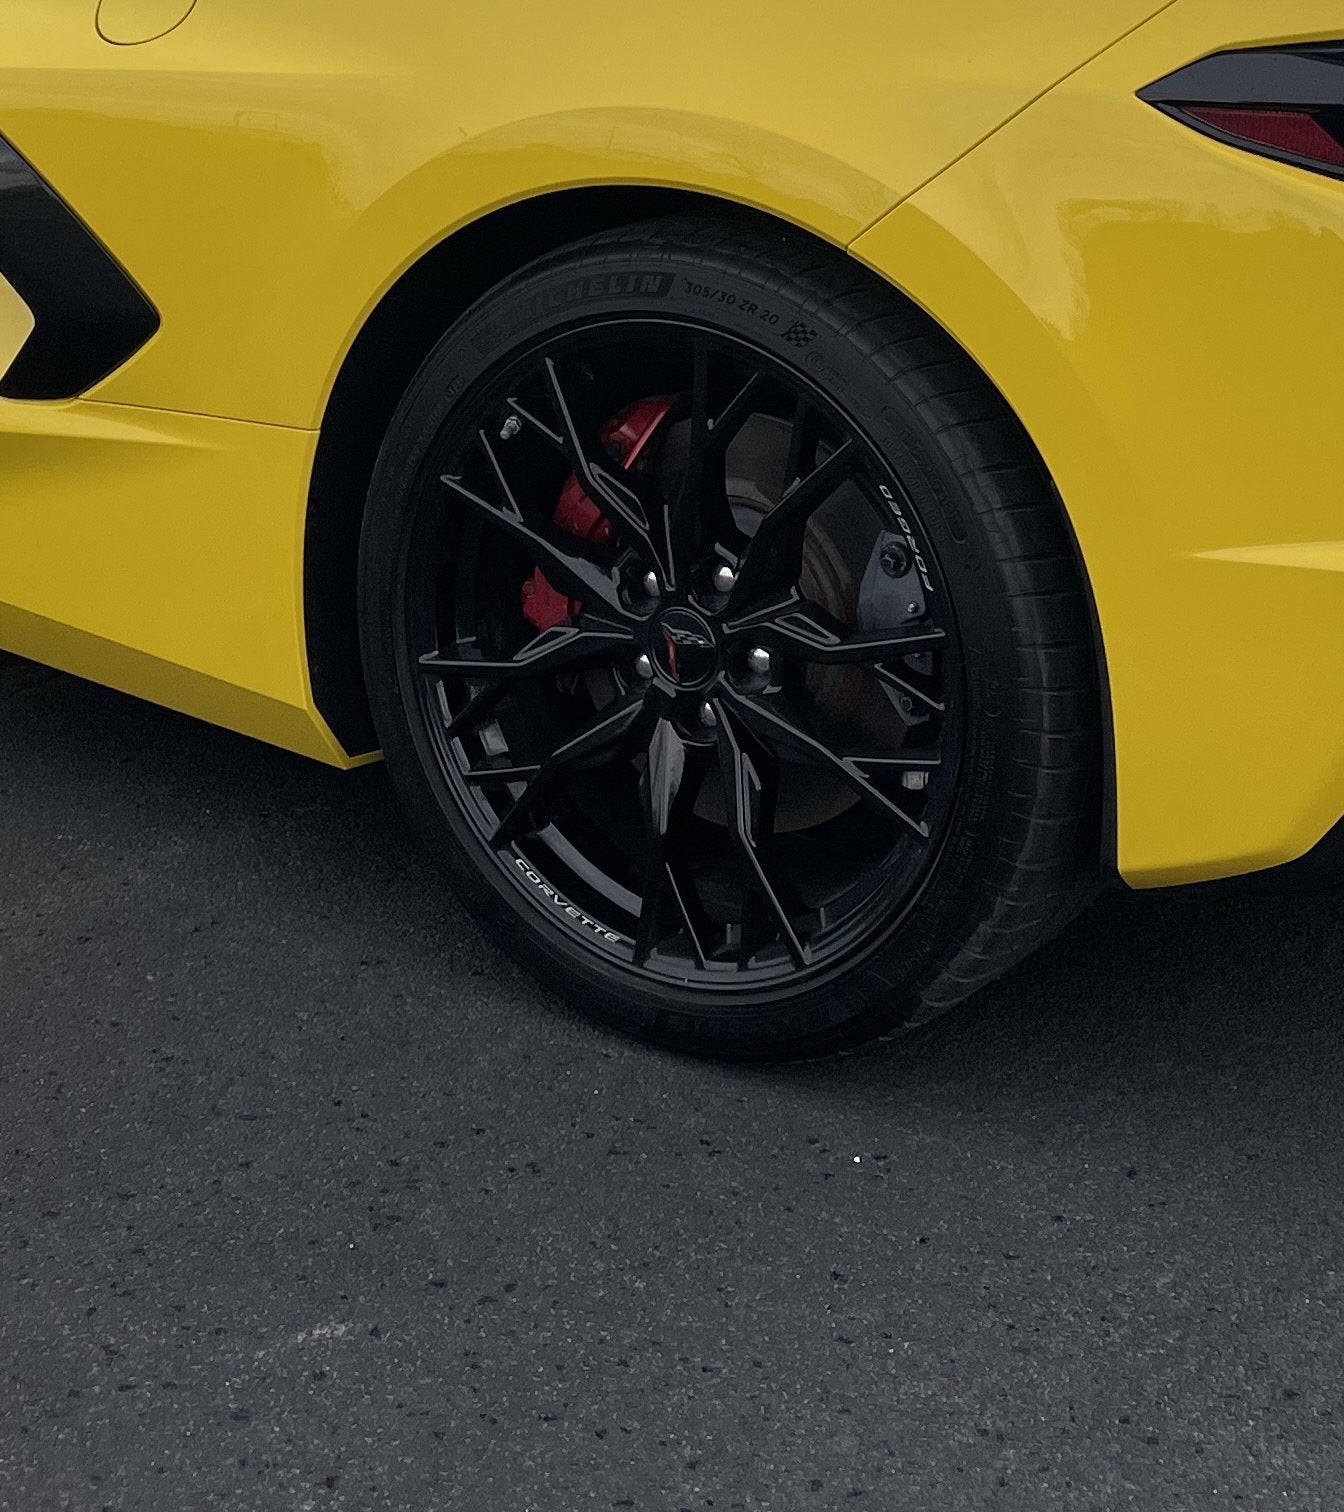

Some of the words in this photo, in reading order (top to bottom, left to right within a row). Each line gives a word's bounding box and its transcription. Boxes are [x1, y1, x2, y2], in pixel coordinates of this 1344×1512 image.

[683, 281, 737, 306] 305/30
[738, 297, 759, 315] ZR
[759, 309, 780, 326] 20
[878, 484, 934, 592] FORGED
[515, 858, 622, 945] CORVETTE
